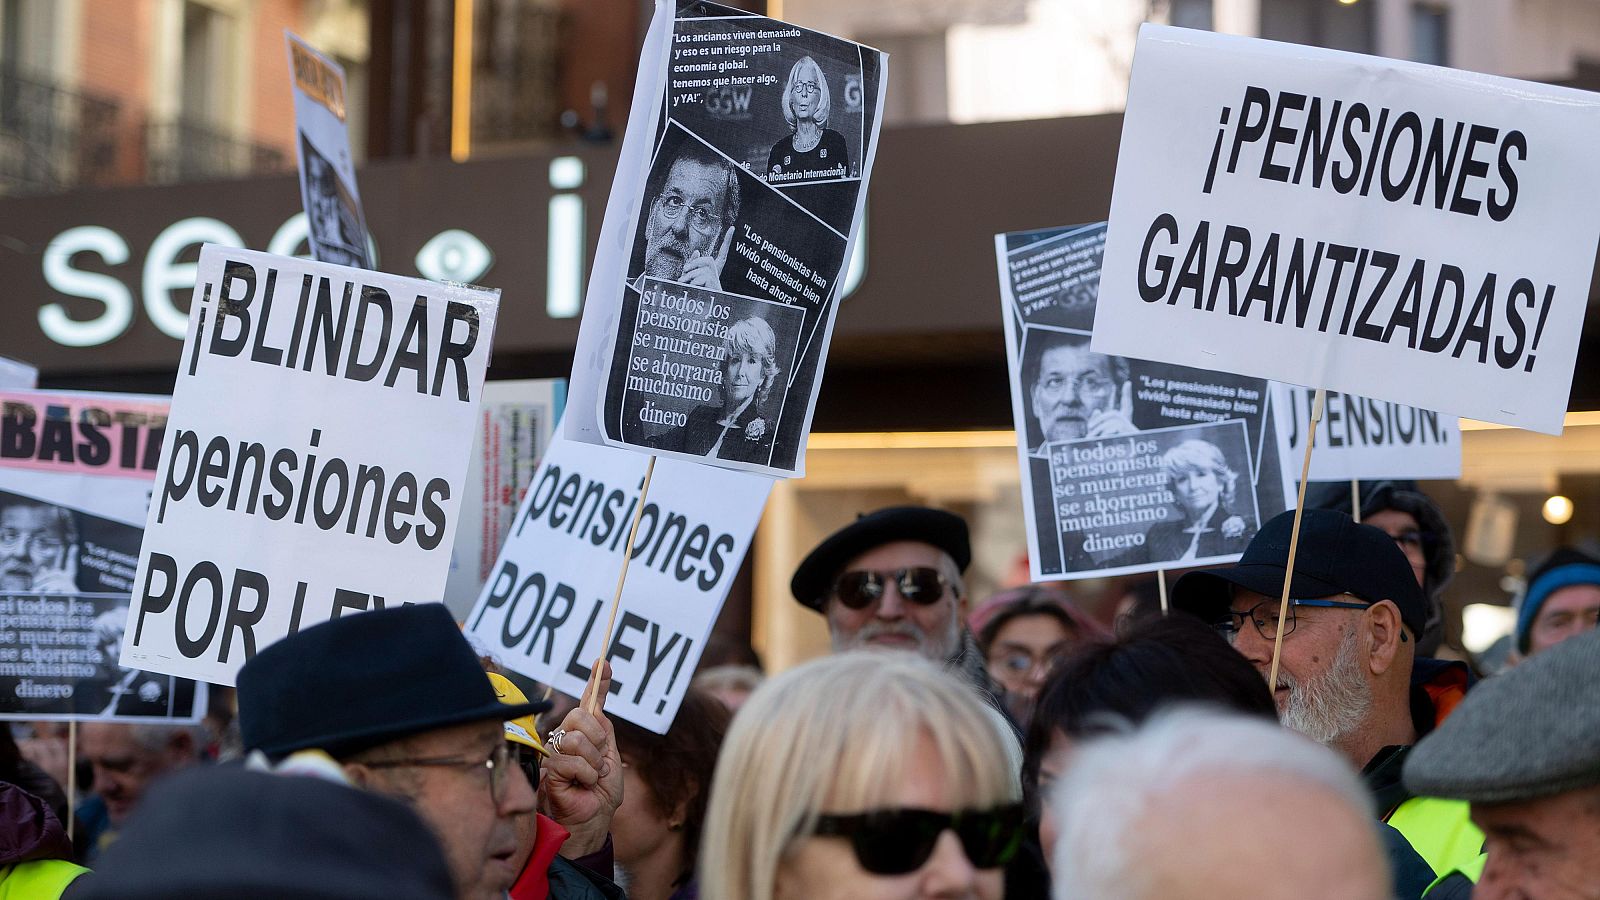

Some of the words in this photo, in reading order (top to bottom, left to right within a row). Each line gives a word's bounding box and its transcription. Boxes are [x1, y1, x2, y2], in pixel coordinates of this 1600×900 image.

[692, 31, 732, 42] ancianos
[732, 30, 756, 41] viven
[757, 28, 801, 39] demasiado
[674, 48, 681, 59] y
[683, 48, 698, 56] eso
[699, 47, 709, 56] es
[711, 46, 723, 56] un
[724, 44, 751, 56] riesgo
[752, 43, 771, 55] para
[773, 42, 781, 52] la
[718, 59, 749, 73] global.
[673, 77, 711, 88] tenemos
[713, 76, 730, 89] que
[731, 75, 756, 85] hacer
[756, 74, 778, 86] algo,
[673, 96, 680, 106] y
[1202, 85, 1528, 223] ¡PENSIONES
[768, 170, 803, 182] Monetario
[803, 166, 847, 179] Internacional
[743, 223, 762, 245] "Los
[761, 240, 812, 278] pensionistas
[811, 270, 827, 289] han
[38, 212, 380, 347] se
[736, 241, 761, 264] vivido
[761, 258, 803, 292] demasiado
[803, 284, 821, 305] bien
[745, 267, 769, 291] hasta
[769, 285, 798, 305] ahora"
[642, 285, 657, 307] si
[660, 290, 705, 314] todos
[707, 296, 731, 320] los
[1137, 213, 1556, 374] GARANTIZADAS!
[188, 260, 481, 402] ¡BLINDAR
[640, 309, 733, 340] pensionista
[634, 331, 651, 348] se
[653, 334, 726, 361] murieran
[632, 356, 649, 372] se
[639, 401, 687, 427] dinero
[1052, 445, 1069, 466] si
[1073, 441, 1127, 463] todos
[1129, 437, 1158, 458] los
[1055, 454, 1167, 483] pensionista
[157, 428, 452, 551] pensiones
[1055, 483, 1076, 499] se
[1079, 471, 1168, 495] murieran
[1060, 500, 1081, 517] se
[515, 463, 735, 592] pensiones
[1082, 532, 1146, 553] dinero
[0, 613, 98, 632] pensionista
[132, 551, 270, 665] POR
[472, 560, 577, 666] POR
[565, 599, 693, 716] LEY!
